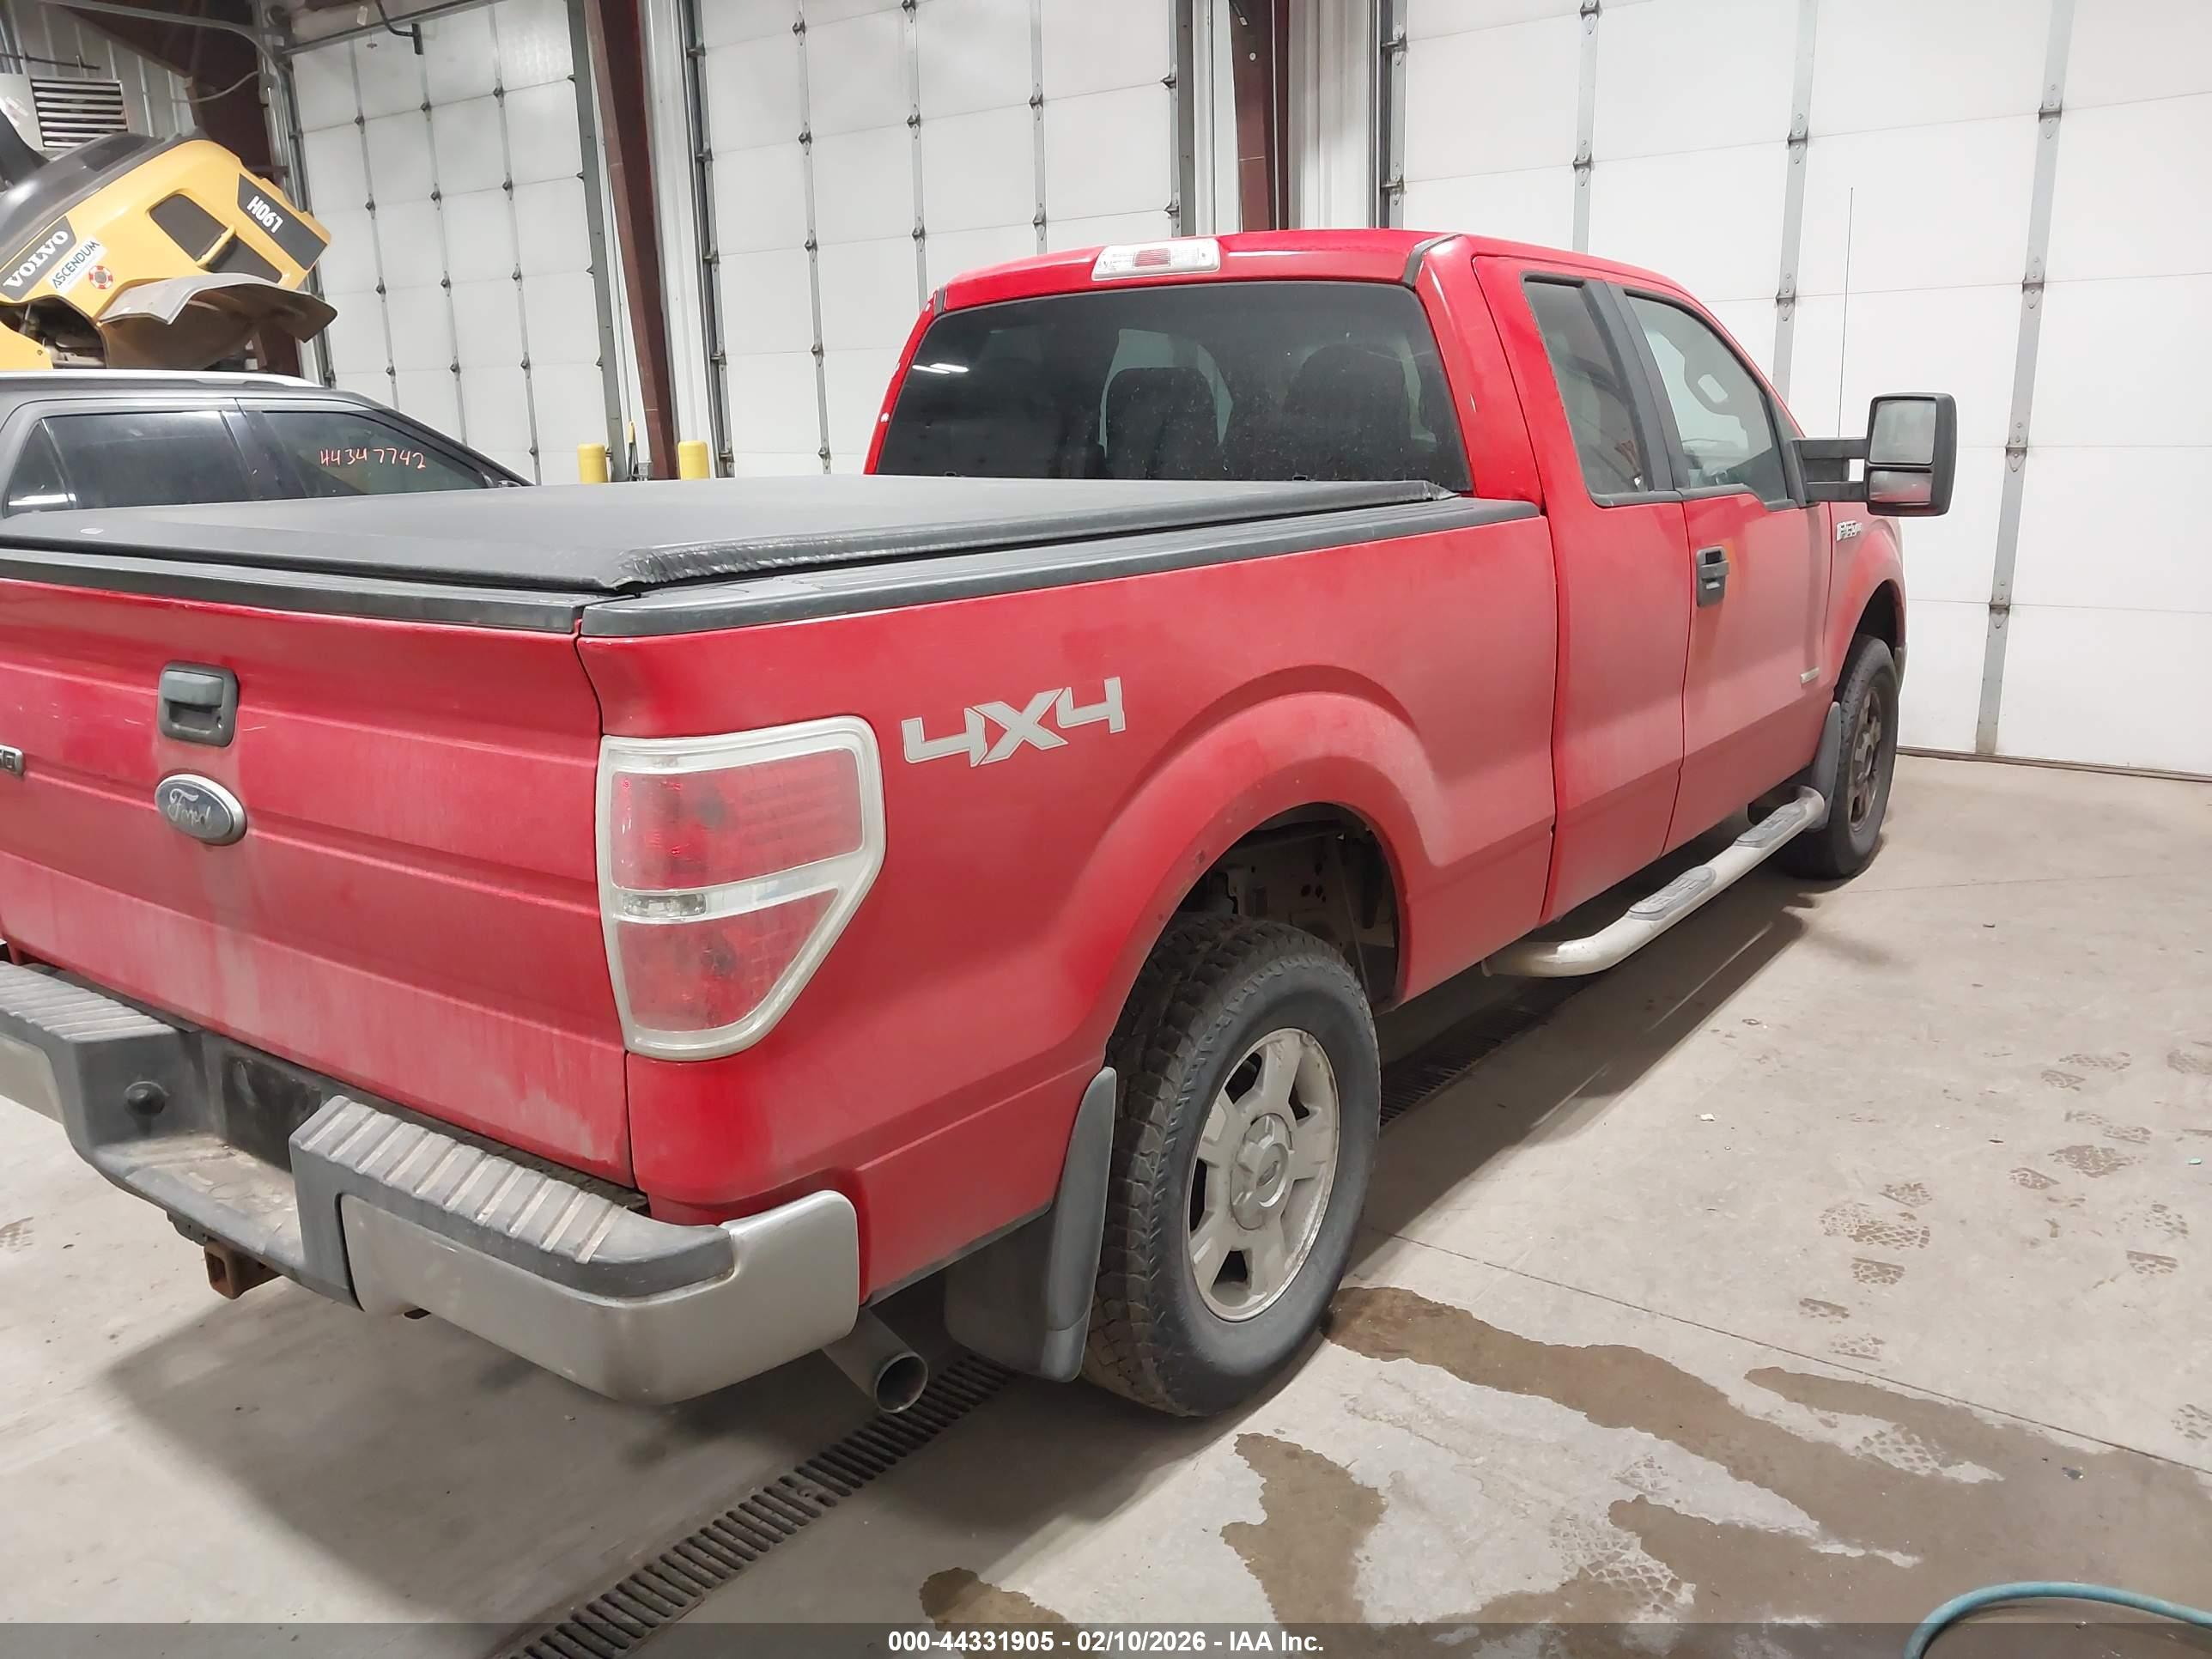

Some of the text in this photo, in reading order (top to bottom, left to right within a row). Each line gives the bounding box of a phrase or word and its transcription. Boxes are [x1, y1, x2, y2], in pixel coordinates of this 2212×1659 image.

[3, 231, 68, 287] VOLVO
[52, 240, 100, 289] ASCENDUM
[167, 788, 212, 830] Ford
